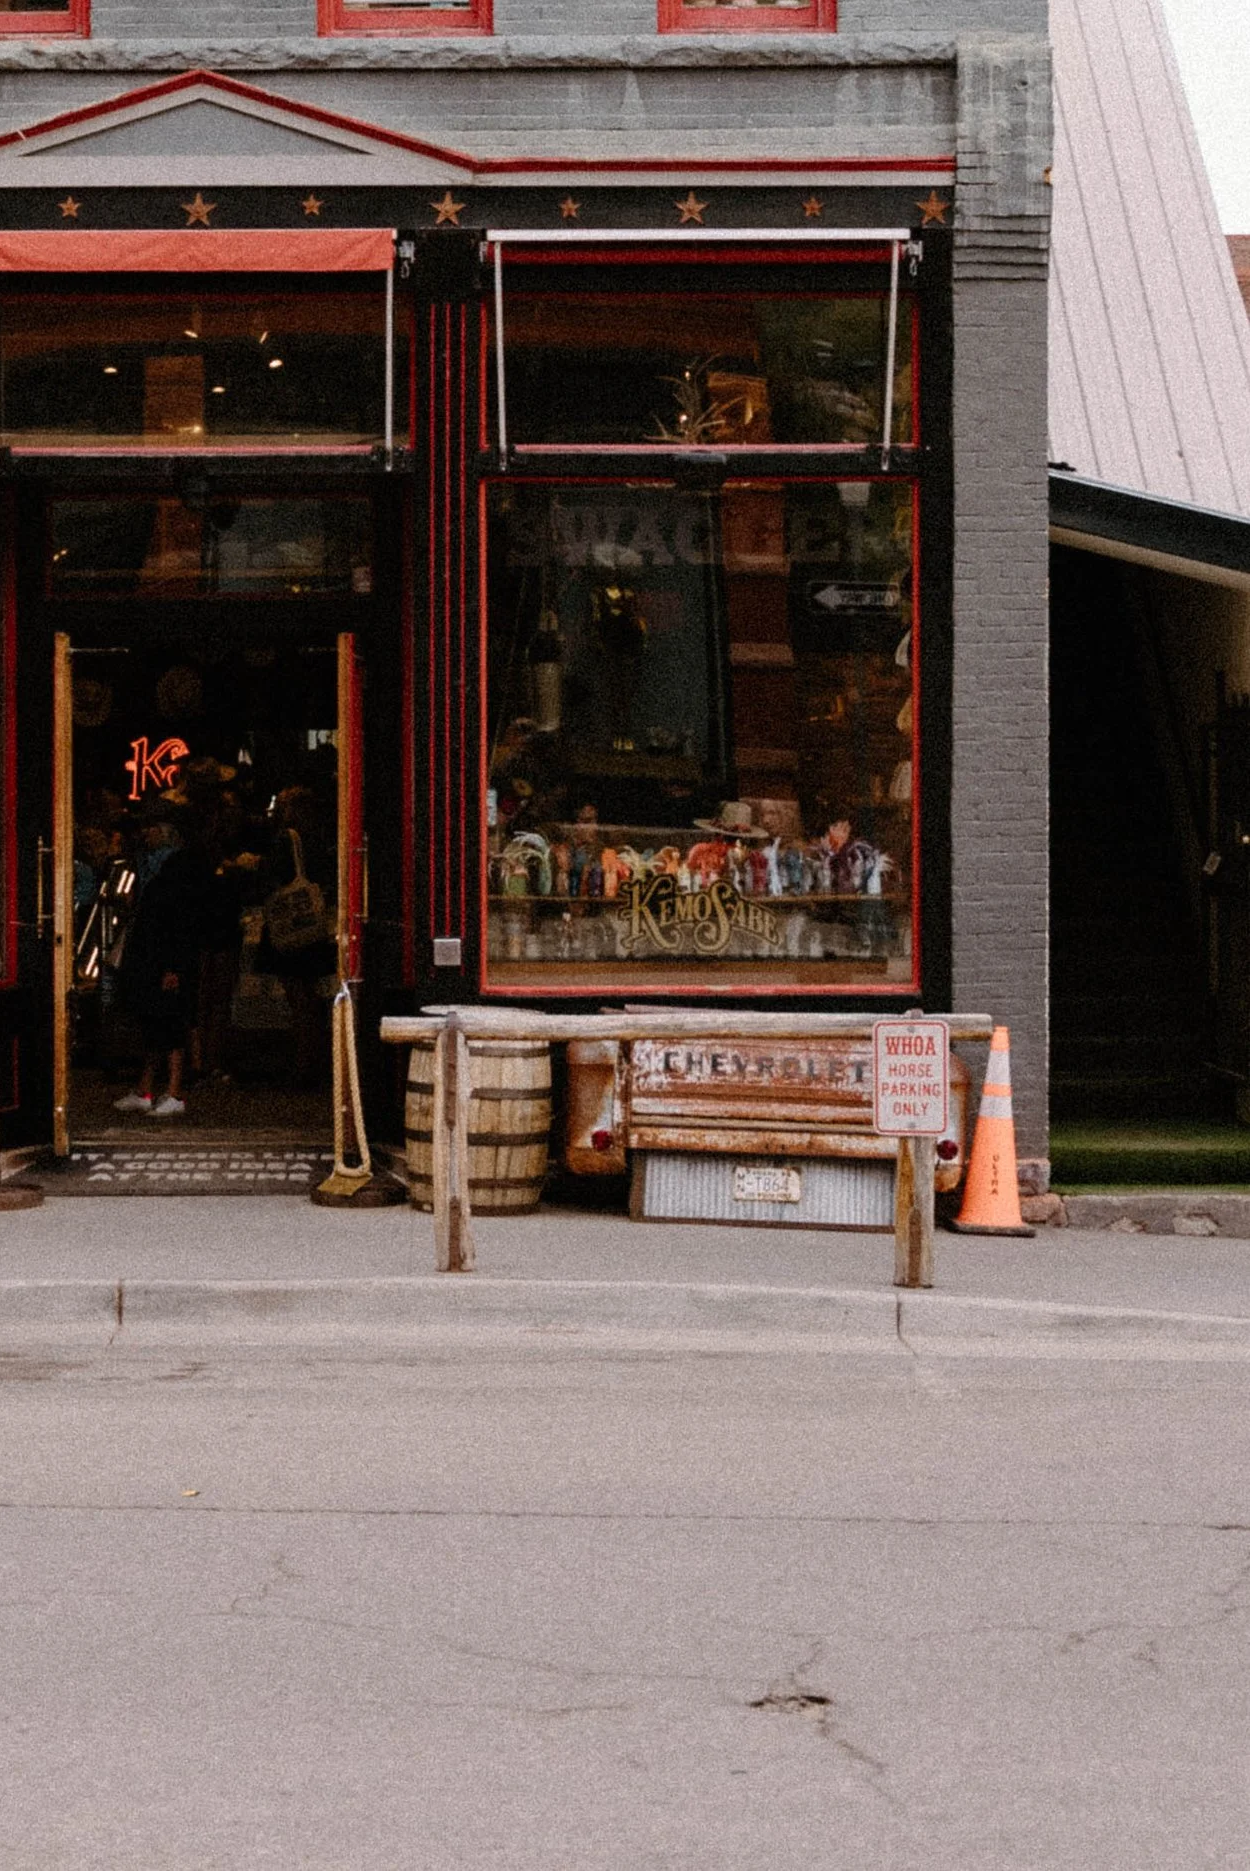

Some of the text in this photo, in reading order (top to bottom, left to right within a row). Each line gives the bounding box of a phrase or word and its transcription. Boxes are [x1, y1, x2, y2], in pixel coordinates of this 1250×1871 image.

[885, 1035, 937, 1056] WHOA
[662, 1050, 871, 1084] CHEVROLET
[888, 1064, 934, 1078] HORSE
[881, 1082, 941, 1096] PARKING
[893, 1101, 929, 1116] ONLY
[90, 1162, 313, 1171] A GOOD IDEA
[87, 1172, 137, 1181] AT
[221, 1172, 310, 1181] TIME
